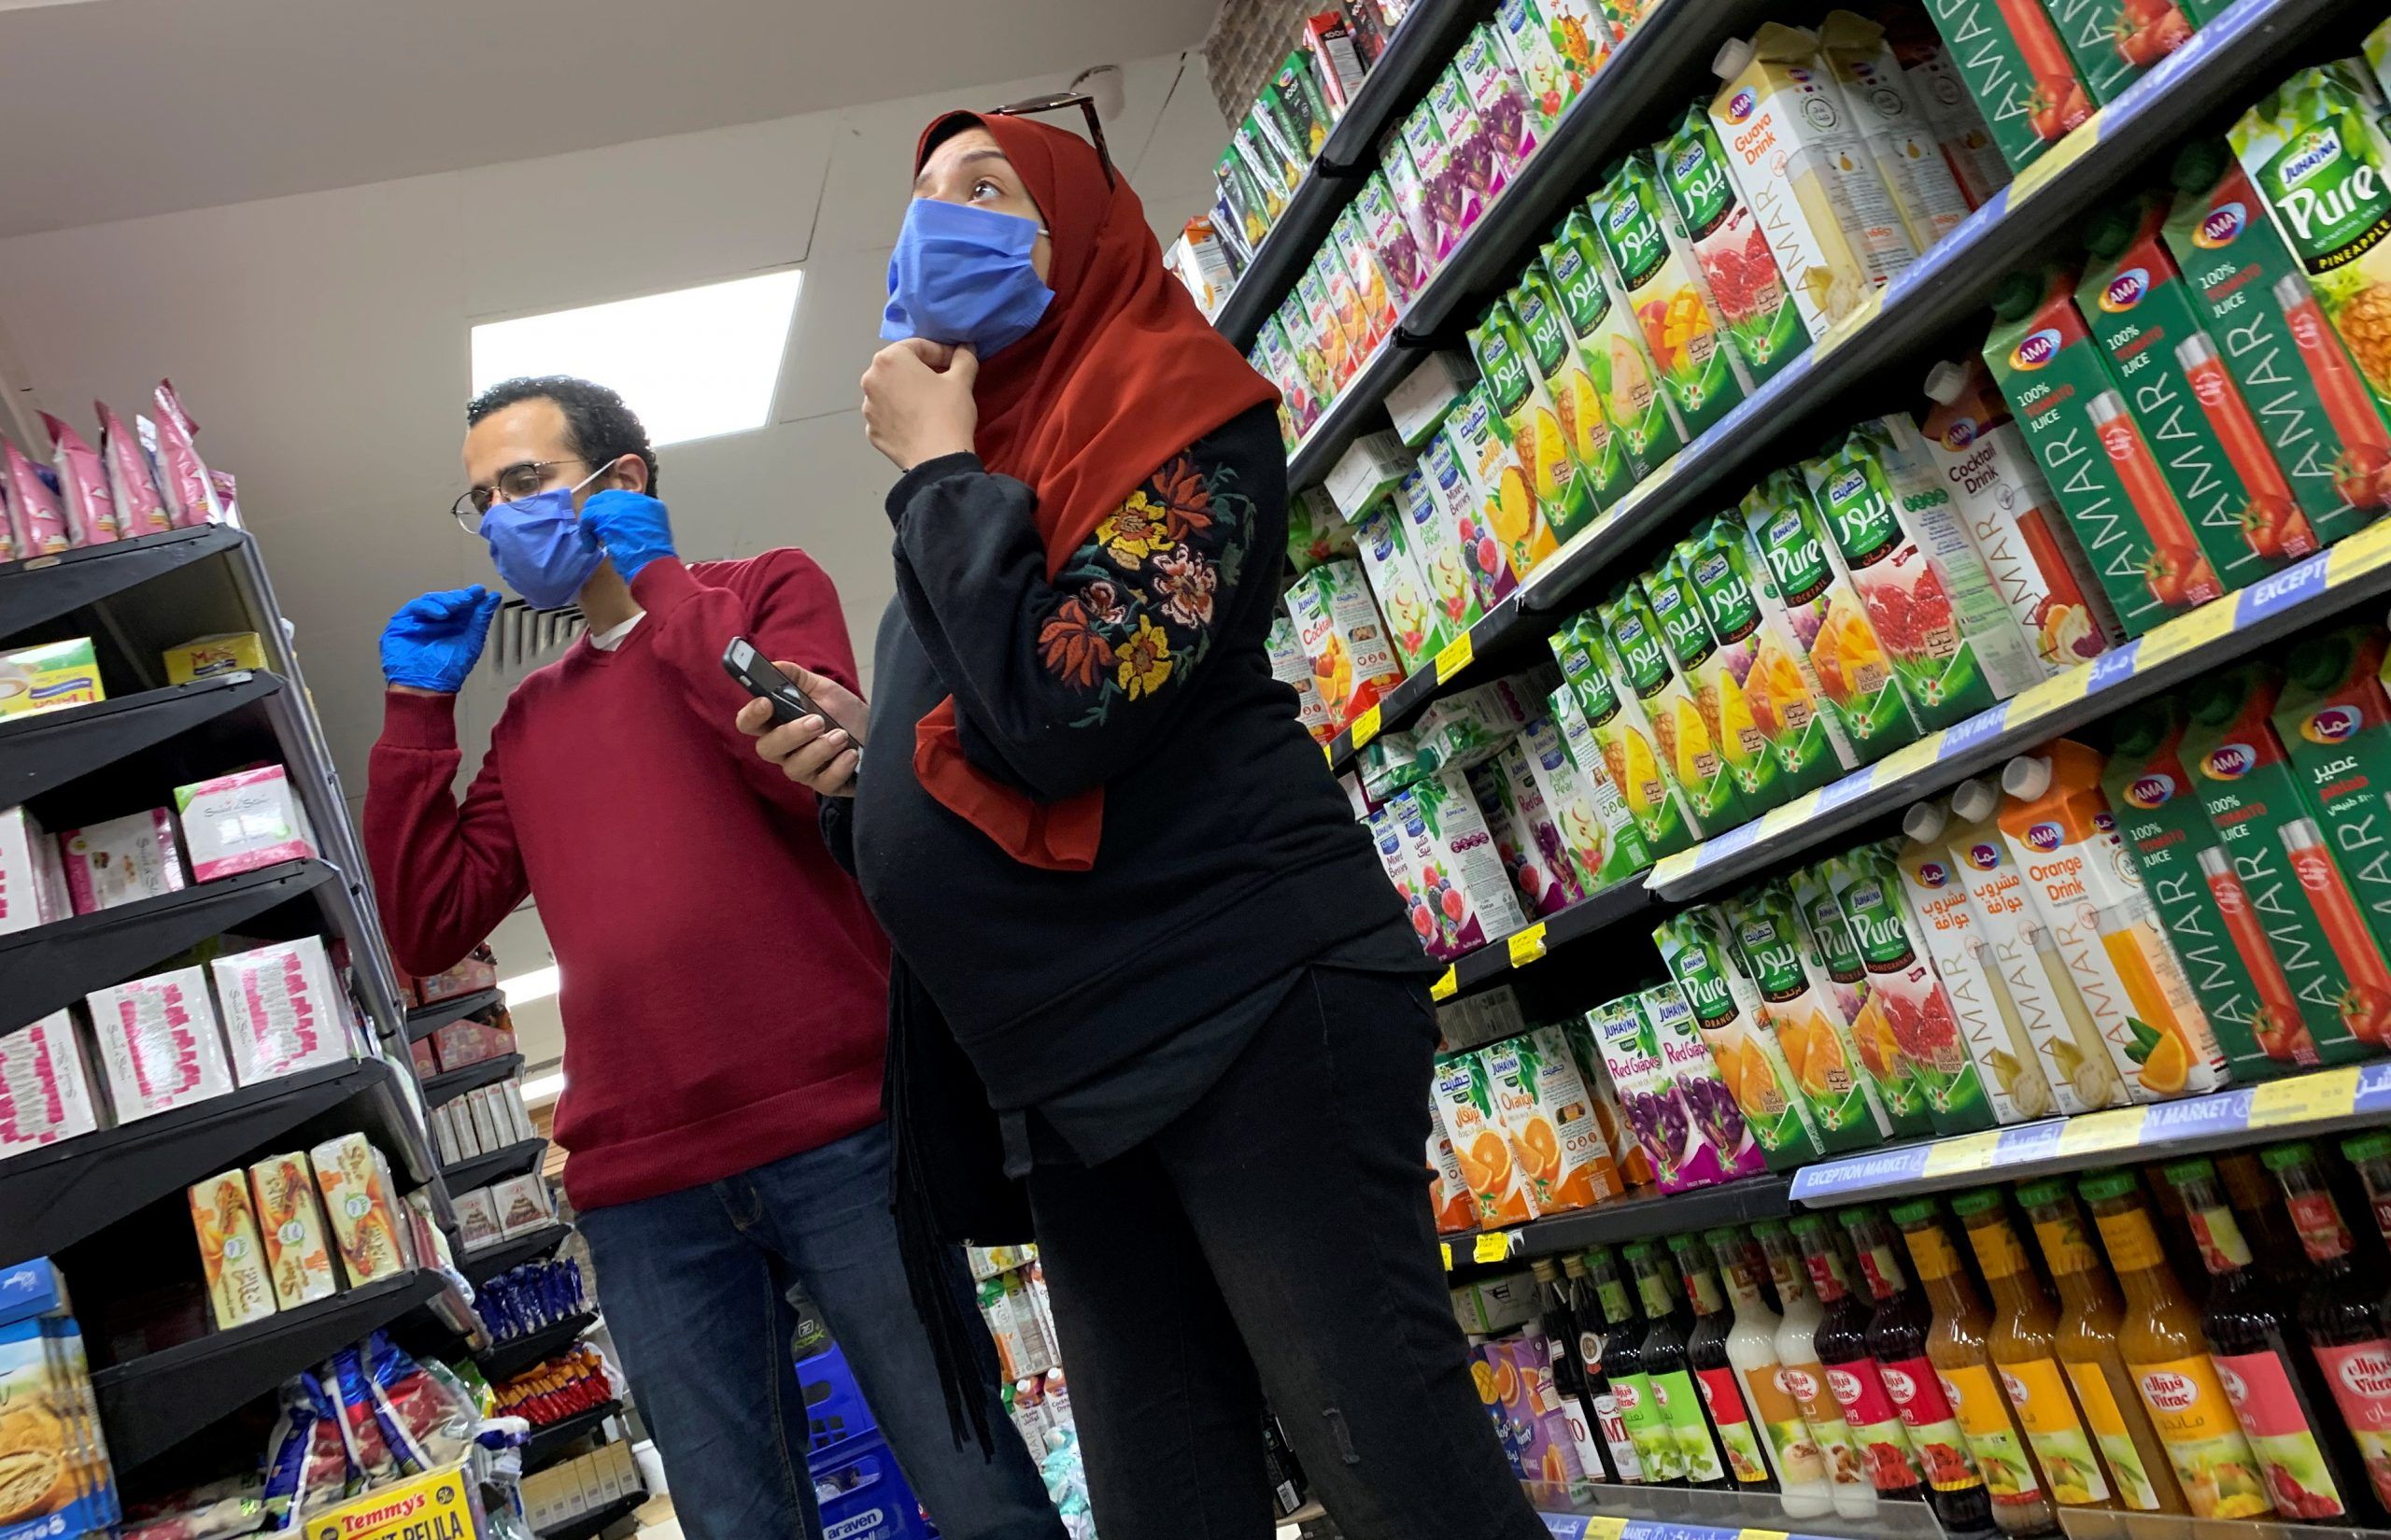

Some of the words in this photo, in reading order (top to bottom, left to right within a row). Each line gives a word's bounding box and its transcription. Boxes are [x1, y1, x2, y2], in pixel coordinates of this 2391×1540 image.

[1733, 112, 1772, 152] Guava
[1744, 131, 1776, 165] Drink
[2285, 140, 2338, 184] JUHAYNA
[2276, 165, 2380, 239] Pure
[2318, 219, 2391, 269] PINEAPPLE
[2200, 261, 2237, 290] 100%
[2212, 292, 2247, 318] JUICE
[2106, 324, 2140, 351] 100%
[2121, 352, 2151, 378] JUICE
[2017, 382, 2051, 407] 100%
[2030, 408, 2061, 432] JUICE
[2227, 312, 2355, 524] LAMAR
[1948, 441, 1997, 484] Cocktail
[2136, 372, 2261, 571] LAMAR
[1446, 480, 1464, 502] Mixed
[1965, 465, 2000, 495] Drink
[1450, 493, 1471, 516] Berries
[1772, 516, 1800, 543] JUHAYNA
[2044, 428, 2163, 618] LAMAR
[1767, 538, 1821, 584] Pure
[1790, 578, 1828, 606] COCKTAIL
[1549, 767, 1571, 785] Apple
[2313, 756, 2359, 785] عصير
[1553, 781, 1574, 797] Pear
[2206, 795, 2242, 815] 100%
[2129, 822, 2163, 841] 100%
[2029, 855, 2084, 883] Orange
[2143, 850, 2172, 869] JUICE
[1973, 872, 2021, 899] مشروب
[2046, 877, 2087, 902] Drink
[1854, 891, 1881, 909] JUHAYNA
[1920, 889, 1968, 916] مشروب
[1987, 895, 2024, 916] جوافة
[1848, 913, 1903, 949] Pure
[1934, 914, 1971, 932] جوافة
[1814, 925, 1853, 959] Pur
[2233, 848, 2357, 1047] LAMAR
[1868, 952, 1915, 973] POMEGRANATE
[2156, 871, 2270, 1062] LAMAR
[1680, 975, 1728, 1009] Pure
[1604, 1017, 1638, 1040] JUHAYNA
[1705, 1010, 1735, 1027] ORANGE
[1493, 1058, 1519, 1075] JUHAYNA
[1440, 1073, 1471, 1093] جهينة
[1500, 1092, 1535, 1112] Orange
[2161, 1097, 2232, 1126] MARKET
[1806, 1163, 1864, 1187] EXCEPTION
[1864, 1153, 1910, 1179] MARKET
[2355, 1378, 2391, 1393] Vitra
[2150, 1392, 2189, 1409] Vitrac
[341, 1493, 426, 1533] Temmy's
[828, 1513, 878, 1540] araven
